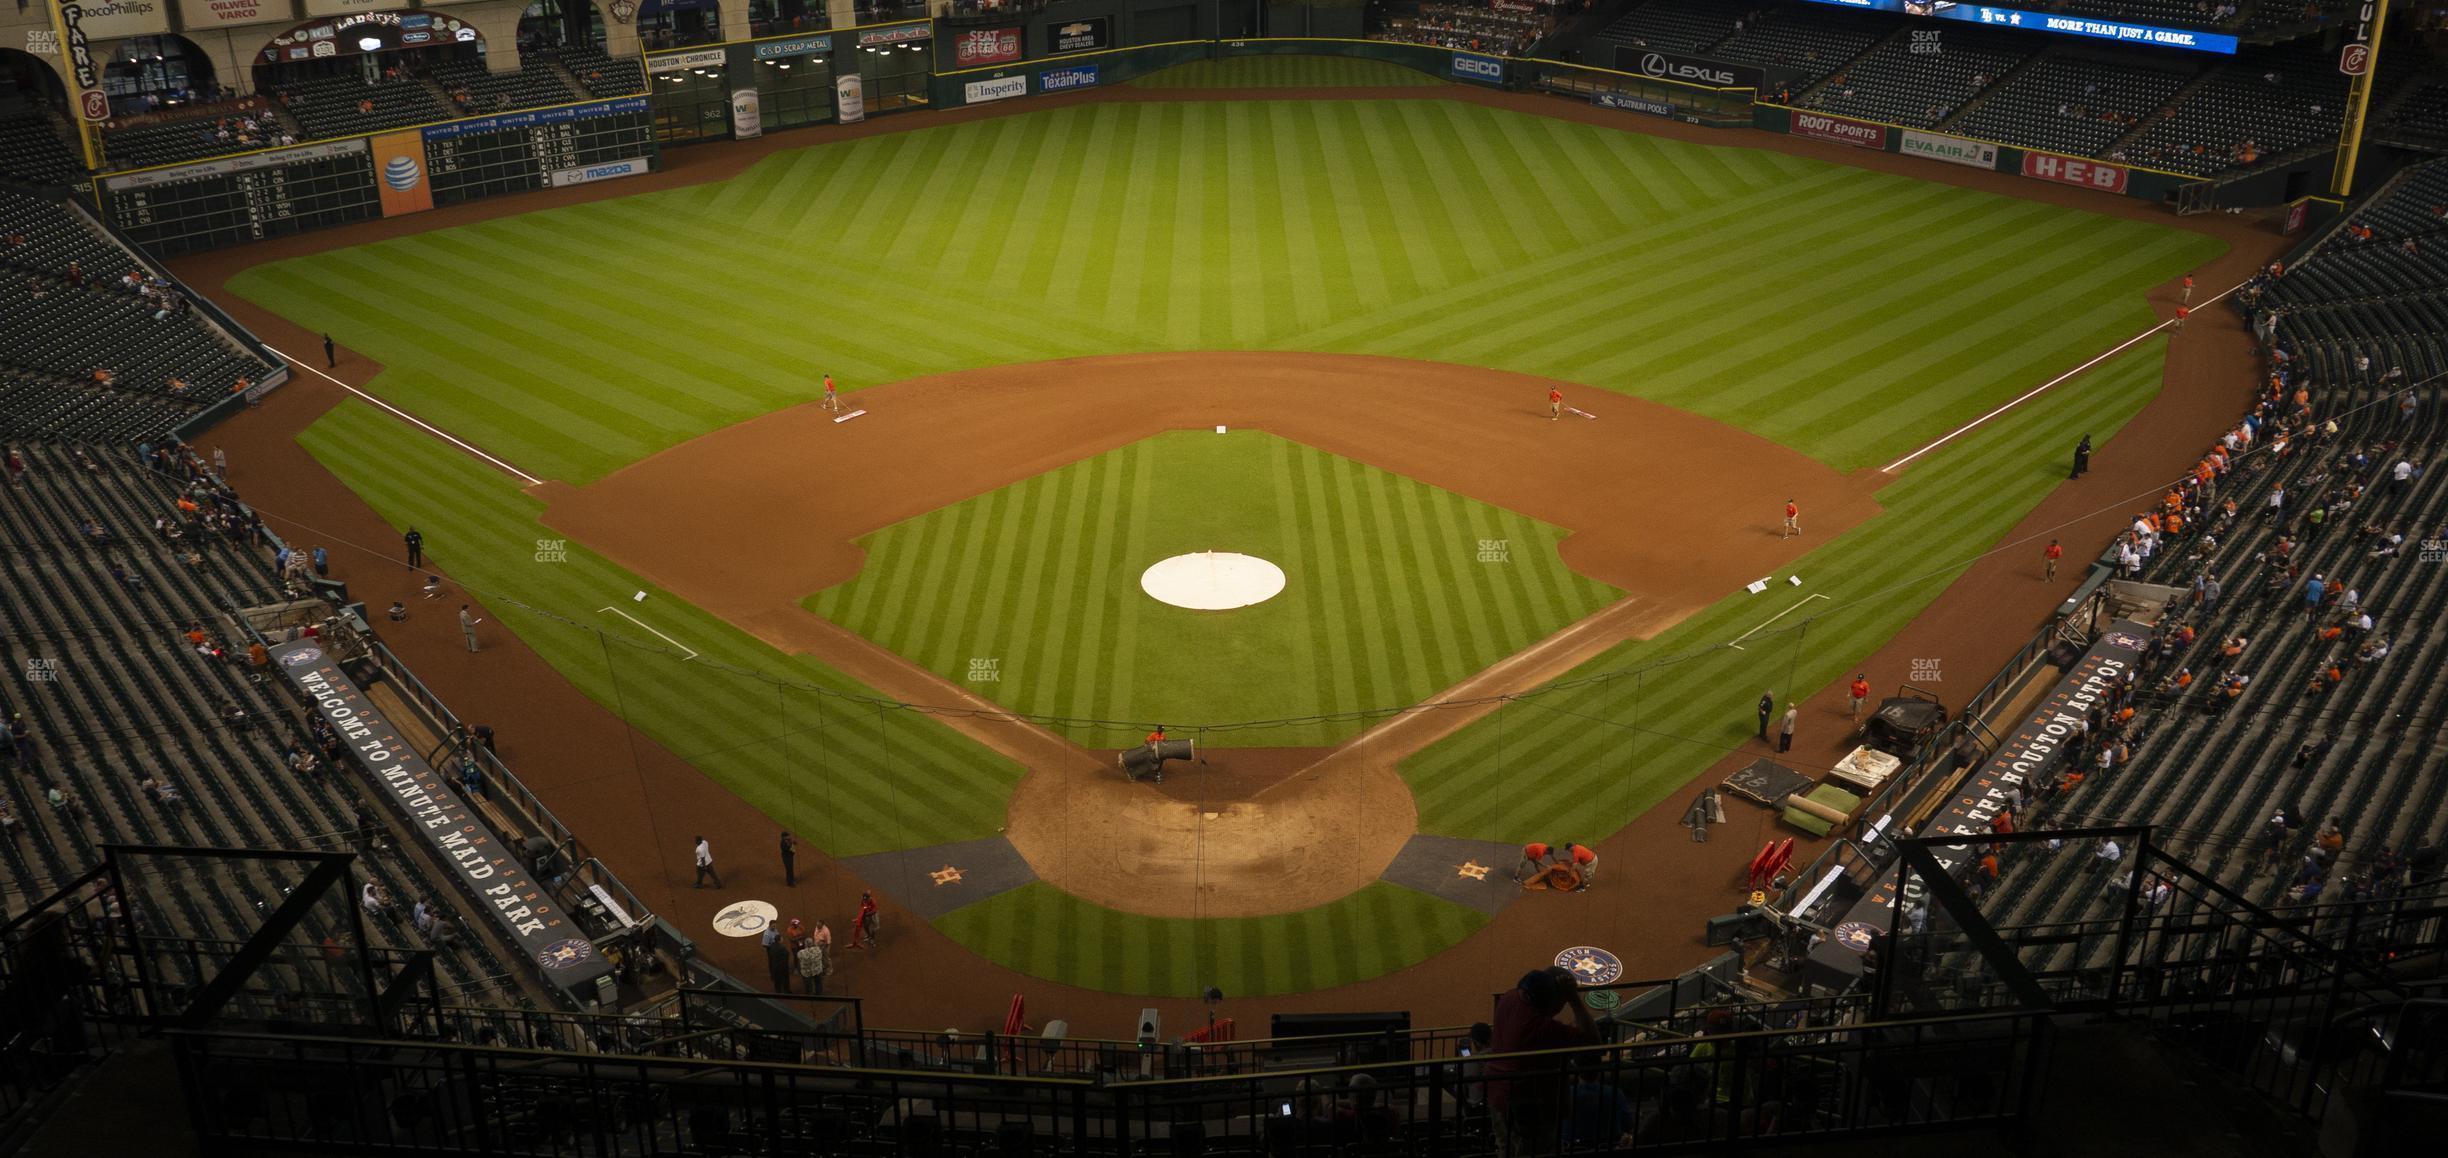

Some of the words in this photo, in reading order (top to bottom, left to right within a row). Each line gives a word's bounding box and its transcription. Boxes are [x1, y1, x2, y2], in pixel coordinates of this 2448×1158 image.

[211, 0, 261, 11] OILWELL
[216, 10, 257, 20] VARCO
[2047, 18, 2083, 32] MORE
[2085, 22, 2117, 37] THAN
[2118, 26, 2143, 40] JUST
[2143, 28, 2153, 40] A
[2155, 30, 2195, 46] GAME.
[63, 6, 95, 87] FARE
[760, 46, 767, 55] C
[774, 45, 782, 54] D
[784, 43, 805, 53] SCRAP
[806, 40, 827, 51] METAL
[1059, 37, 1081, 45] HOUSTON
[1074, 40, 1094, 49] DEALERS
[648, 55, 681, 69] HOUSTON
[685, 51, 721, 64] CHRONICLE
[1454, 57, 1500, 77] GEICO
[1042, 72, 1095, 89] TexanPlus
[1668, 62, 1734, 85] LEXUS
[980, 81, 1025, 96] Insperity
[542, 111, 567, 119] UNITED
[578, 106, 603, 114] UNITED
[704, 110, 721, 119] 362
[1617, 98, 1647, 112] PLATINUM
[1647, 103, 1667, 116] POOLS
[426, 127, 452, 136] UNITED
[464, 121, 489, 130] UNITED
[1799, 114, 1834, 131] ROOT
[1834, 122, 1877, 140] SPORTS
[1905, 138, 1934, 154] EVA
[1935, 142, 1963, 158] AIR
[536, 130, 549, 184] AMERICAN
[586, 163, 631, 179] mazda
[71, 183, 93, 193] 315
[245, 177, 261, 236] NATIONAL
[2034, 693, 2069, 726] MAID
[2001, 713, 2079, 786] HOUSTON
[299, 671, 371, 741] WELCOME
[360, 739, 391, 762] TO
[380, 764, 451, 829] MINUTE
[439, 831, 495, 881] MAID
[484, 883, 546, 937] PARK
[384, 736, 412, 762] THE
[414, 770, 487, 848] HOUSTON
[492, 857, 561, 928] ASTROS
